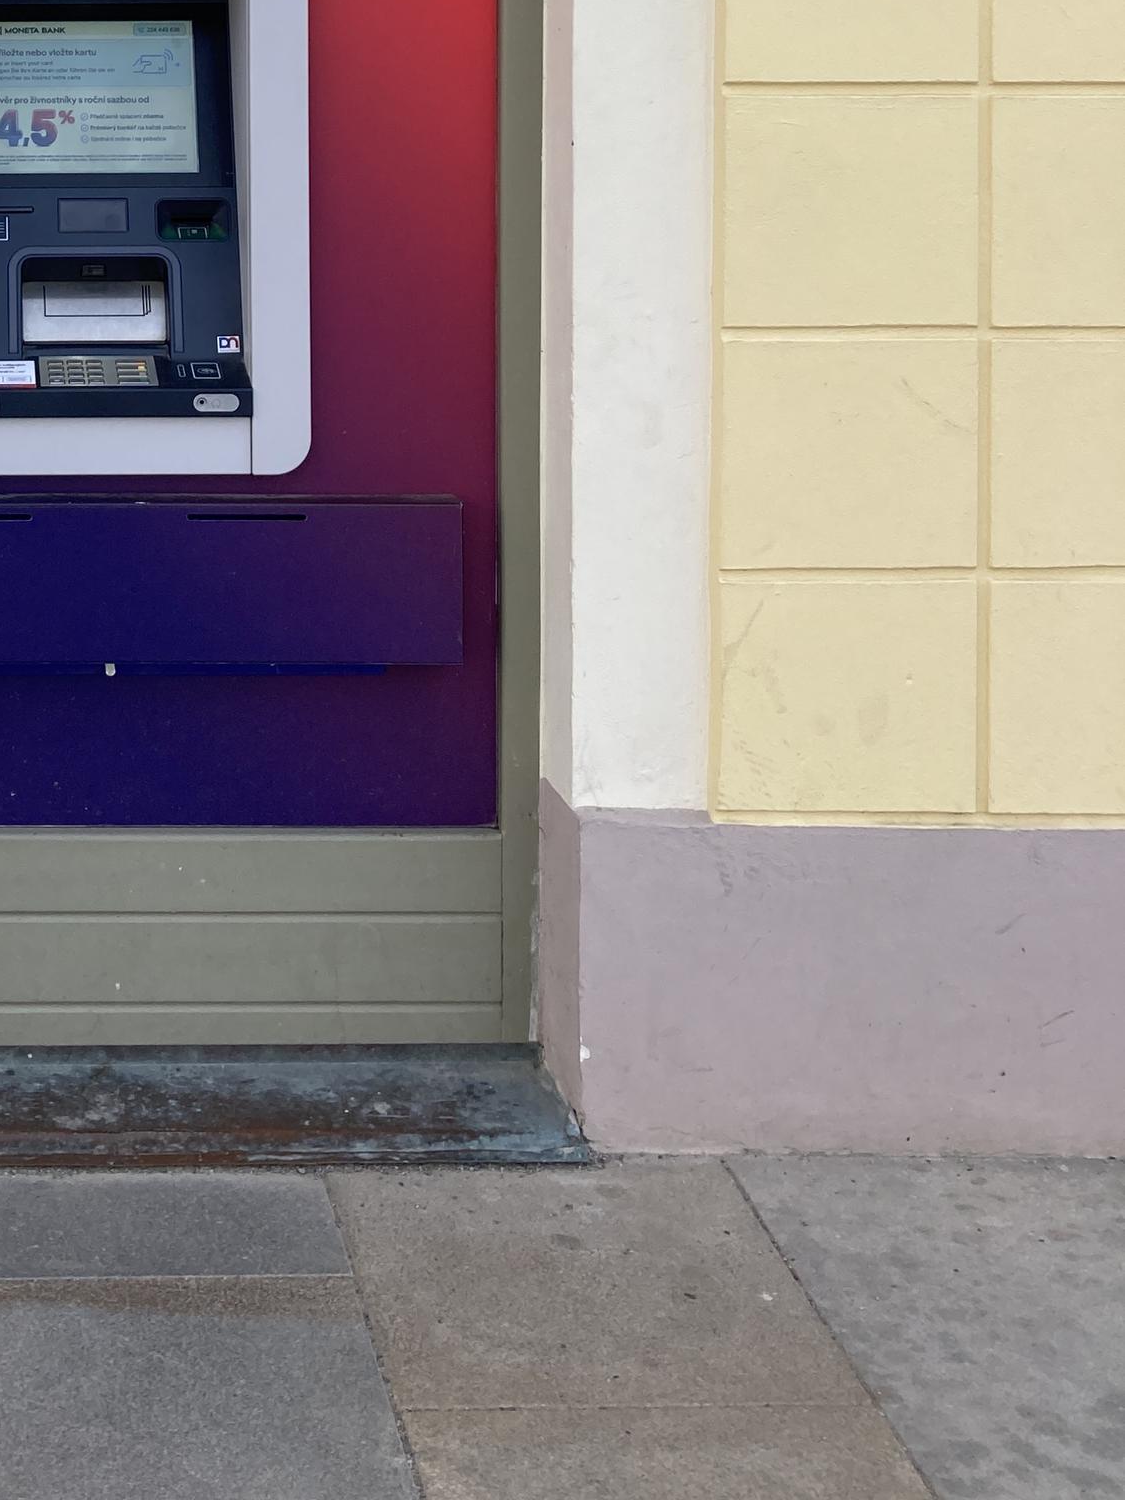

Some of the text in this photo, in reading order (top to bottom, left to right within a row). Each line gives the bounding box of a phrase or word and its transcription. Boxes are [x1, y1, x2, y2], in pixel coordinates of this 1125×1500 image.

[4, 26, 66, 35] MONETA BANK
[25, 49, 47, 57] nebo
[48, 48, 74, 57] vložte
[74, 48, 97, 57] kartu
[106, 96, 137, 104] sazbou
[137, 96, 150, 104] od
